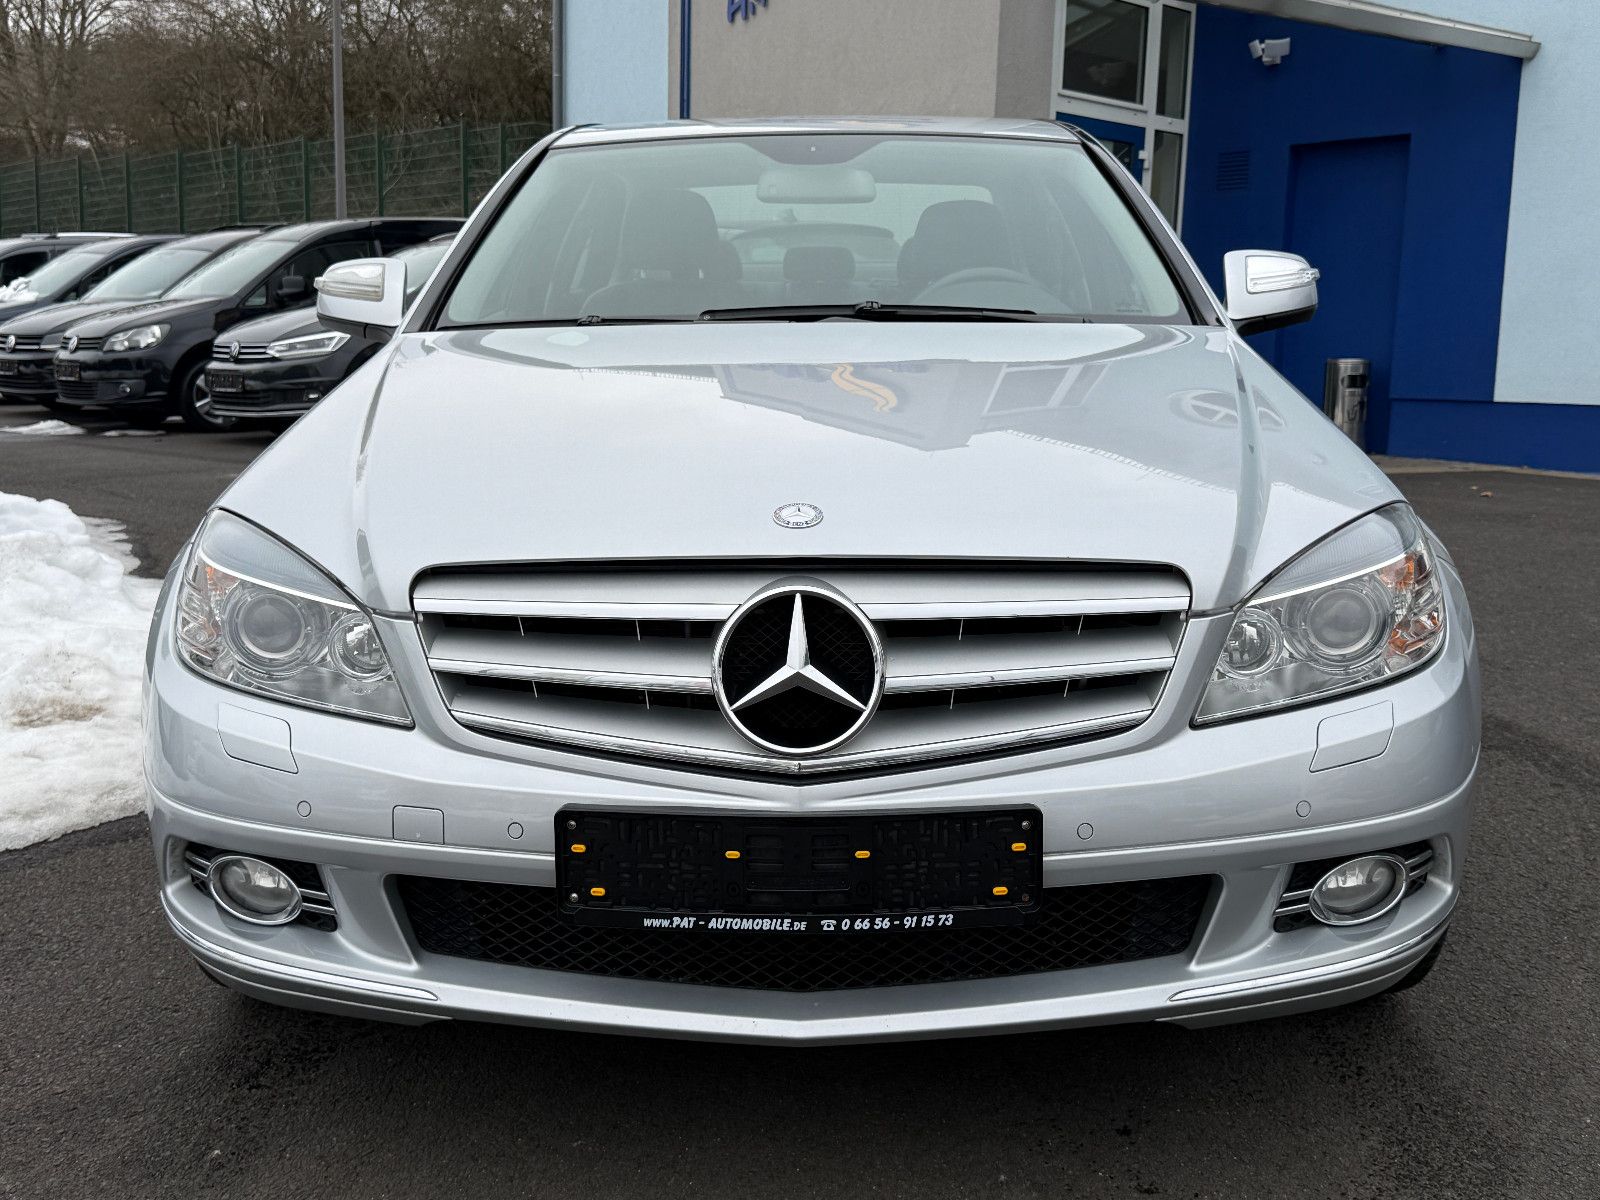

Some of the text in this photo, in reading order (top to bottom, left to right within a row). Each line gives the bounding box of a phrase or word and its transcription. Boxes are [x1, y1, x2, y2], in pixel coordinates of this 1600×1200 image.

[841, 918, 851, 931] 0
[853, 916, 871, 930] 66
[873, 917, 891, 931] 56
[902, 915, 918, 929] 91
[921, 914, 935, 928] 15
[937, 913, 954, 927] 73
